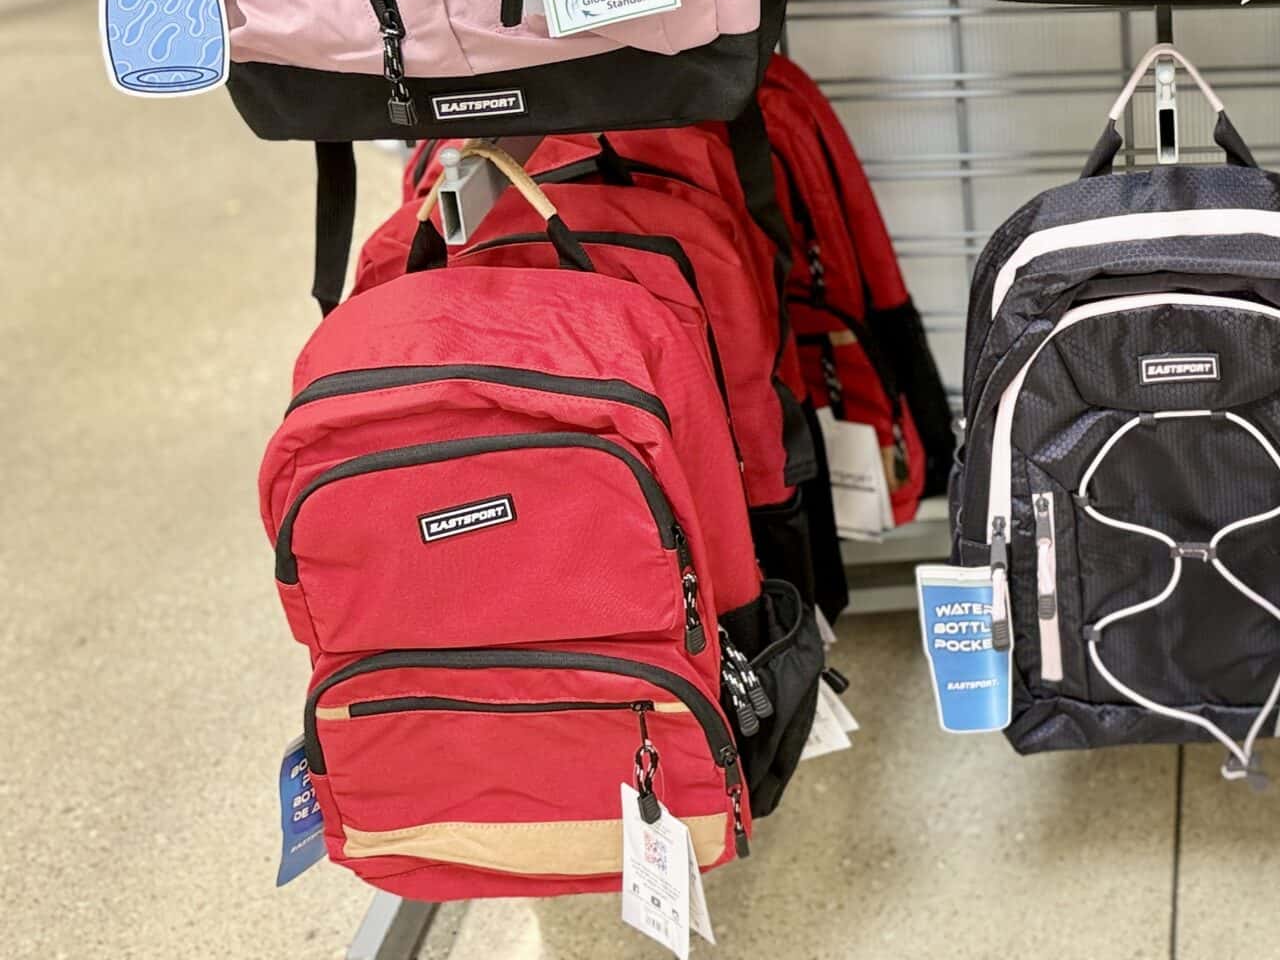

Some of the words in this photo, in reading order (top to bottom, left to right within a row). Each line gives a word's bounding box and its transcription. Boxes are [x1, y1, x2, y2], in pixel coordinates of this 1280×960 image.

[440, 97, 517, 113] EASTSPORT
[1147, 363, 1212, 375] EASTSPORT
[430, 506, 505, 533] EASTSPORT
[934, 622, 991, 634] BOTTL
[934, 639, 992, 651] POCKE
